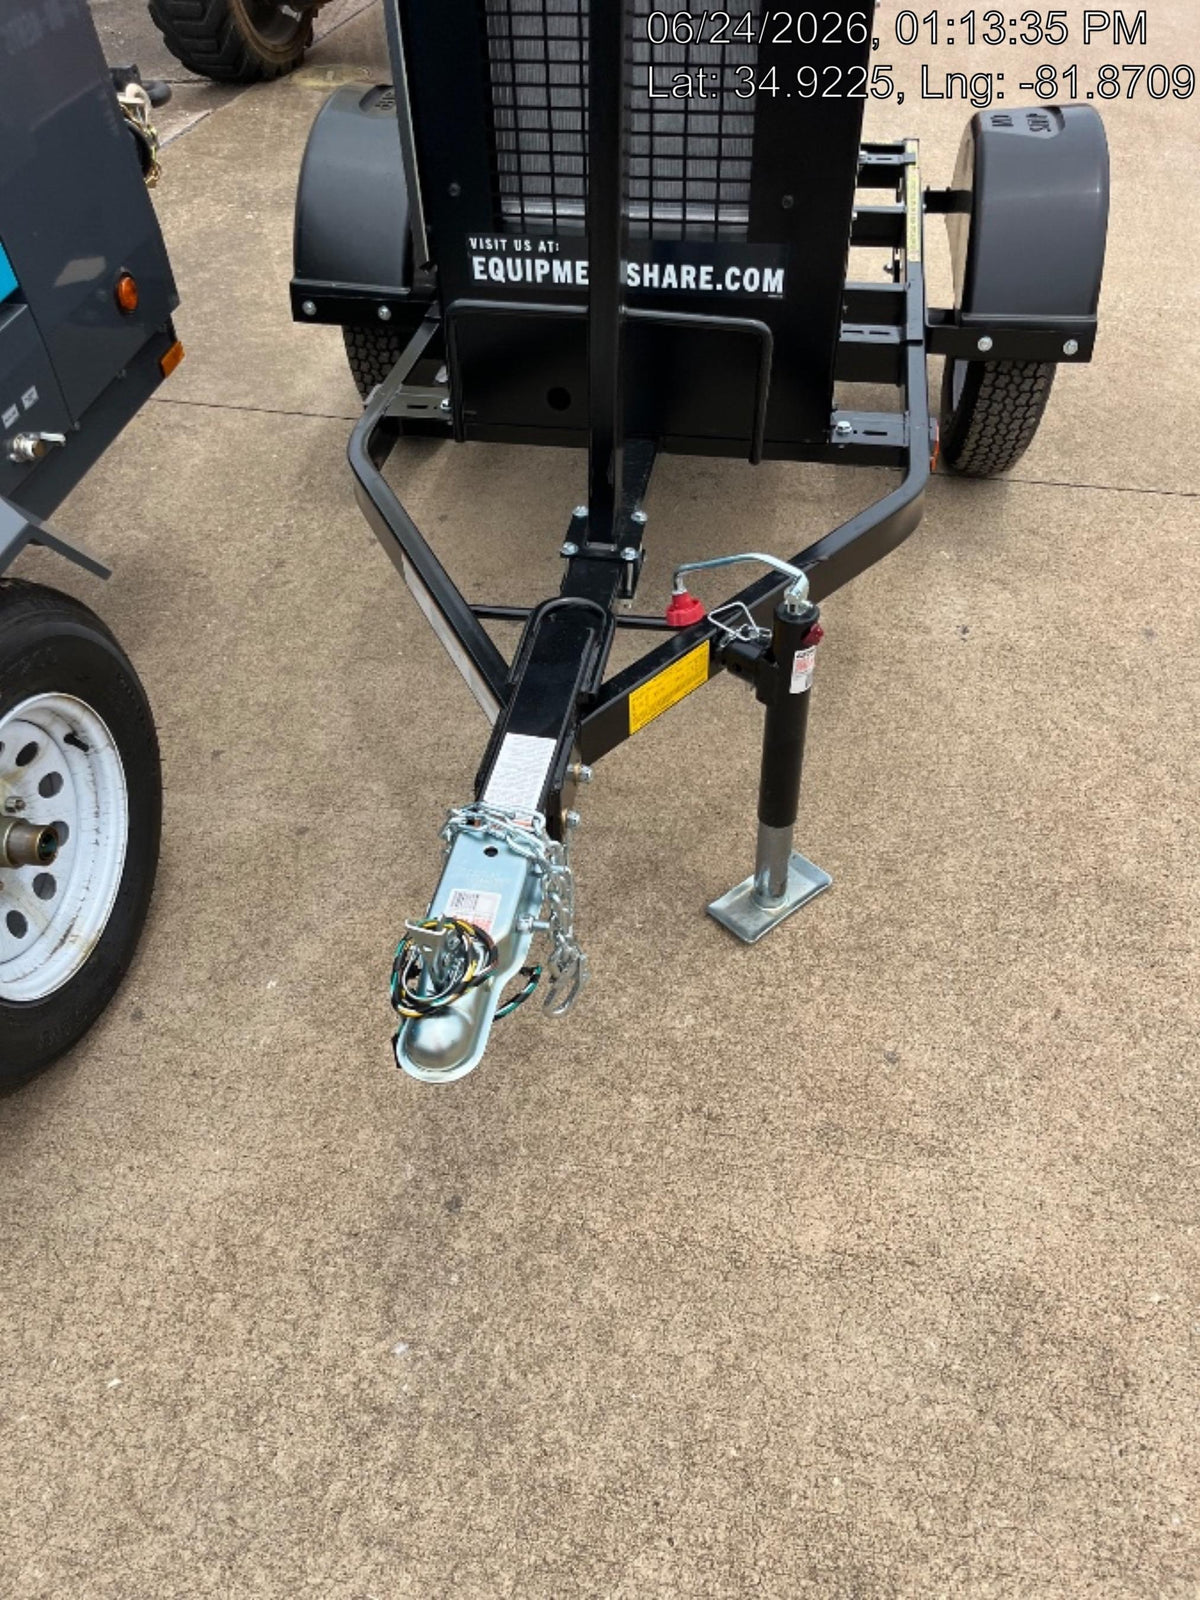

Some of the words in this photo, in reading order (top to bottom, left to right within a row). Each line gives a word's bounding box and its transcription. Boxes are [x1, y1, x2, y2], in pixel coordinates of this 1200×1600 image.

[469, 237, 507, 251] VISIT
[513, 239, 532, 252] US
[538, 241, 560, 253] AT:
[472, 256, 785, 293] EQUIPMESHARE.COM
